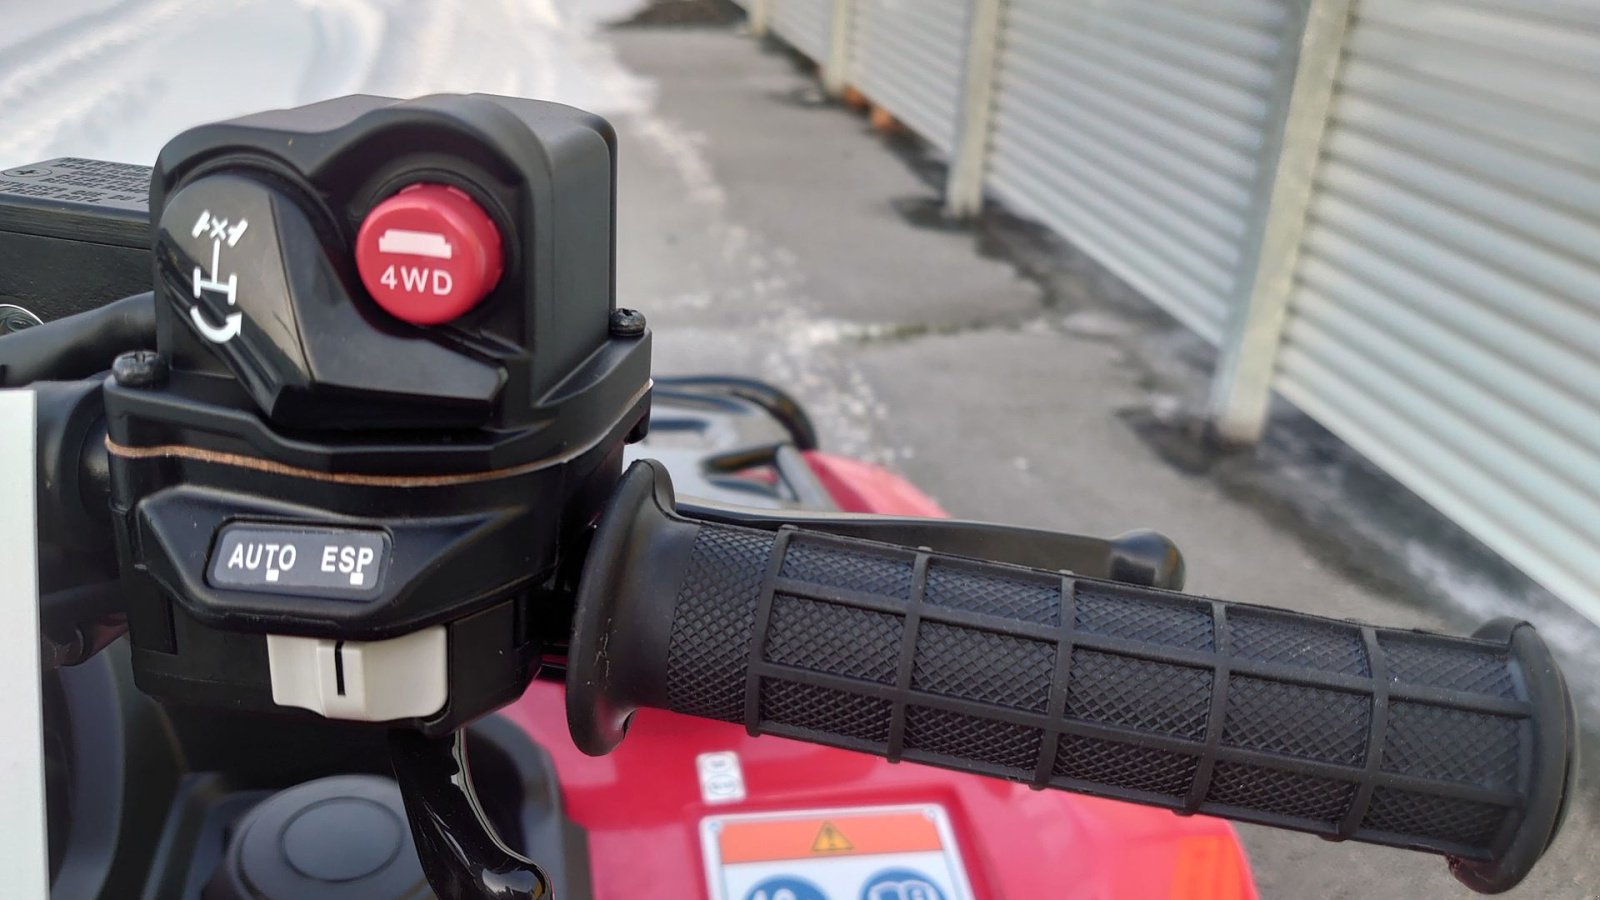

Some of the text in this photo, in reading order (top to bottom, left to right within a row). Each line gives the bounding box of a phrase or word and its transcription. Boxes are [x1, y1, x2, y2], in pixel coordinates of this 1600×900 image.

[380, 265, 453, 296] 4WD
[228, 543, 374, 574] AUTO ESP
